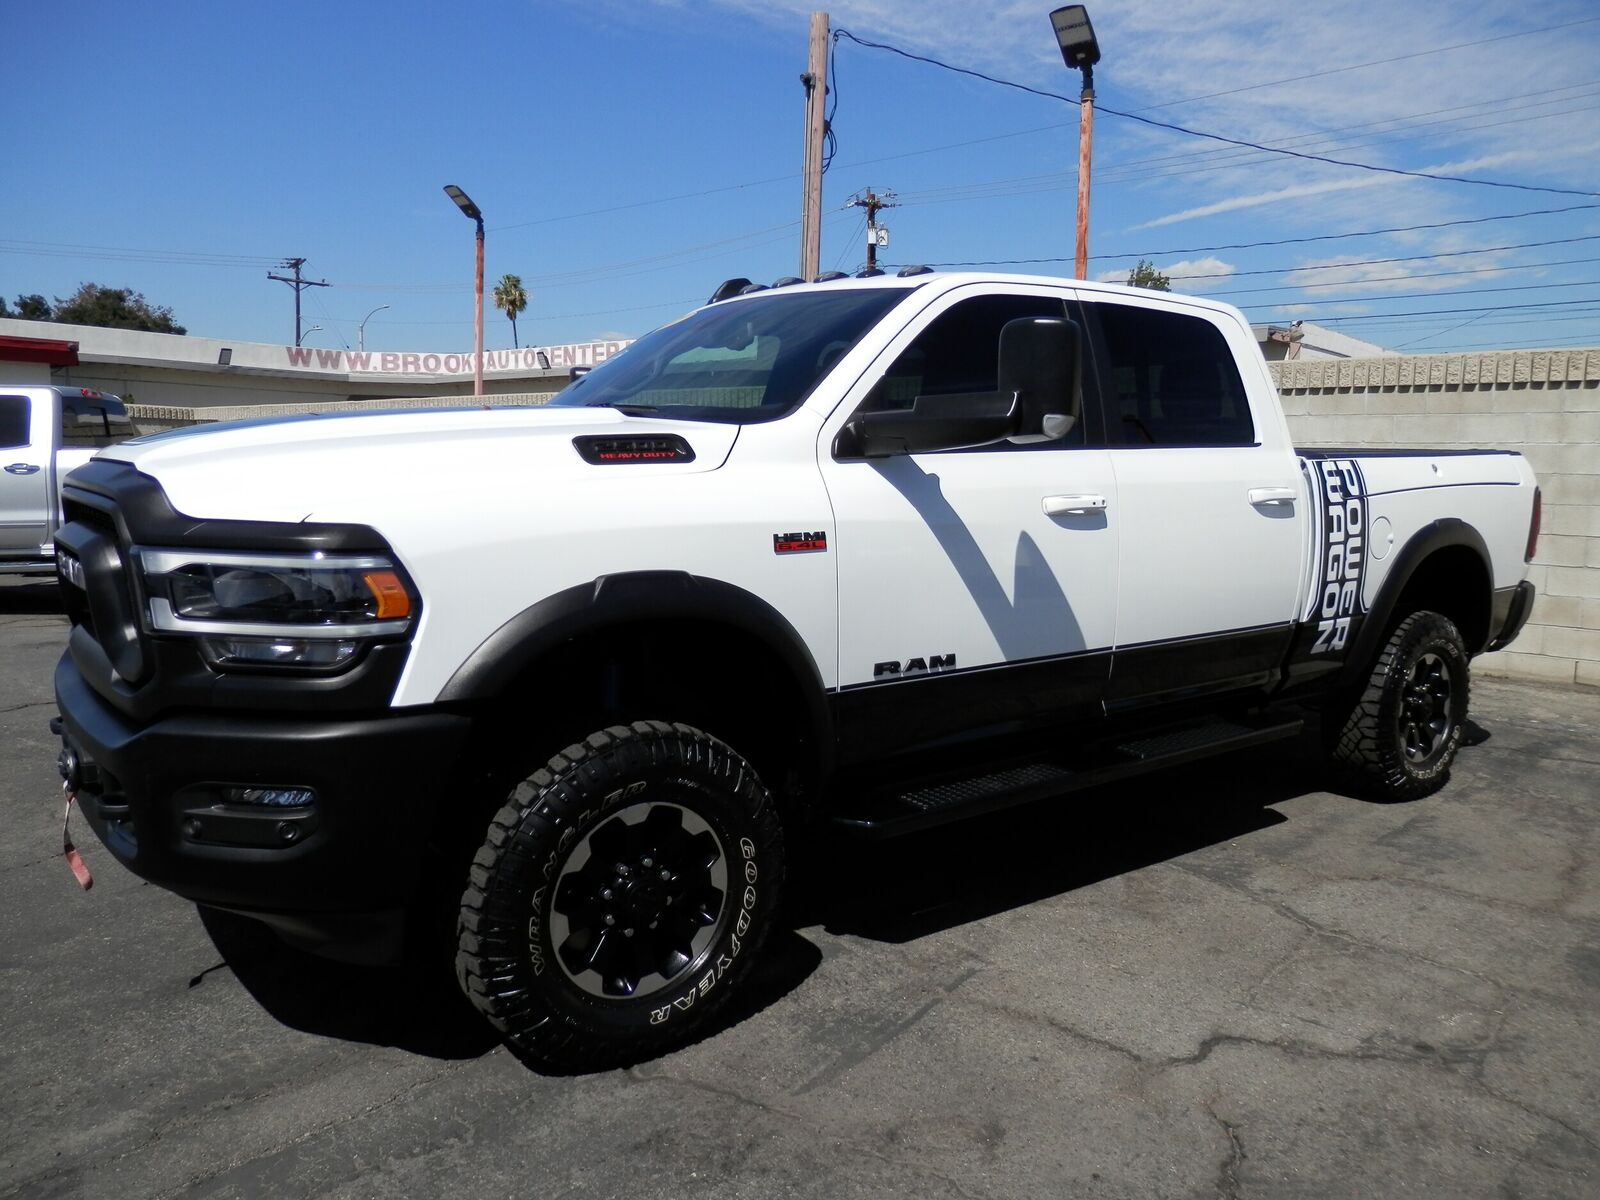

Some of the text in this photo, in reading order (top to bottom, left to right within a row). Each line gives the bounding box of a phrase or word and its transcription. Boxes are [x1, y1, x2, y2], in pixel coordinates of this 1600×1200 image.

[773, 531, 826, 542] HEMI
[1311, 460, 1345, 655] WAGON
[1329, 460, 1362, 652] POWER
[873, 653, 957, 680] RAM
[528, 780, 647, 976] WRANGLER
[650, 837, 758, 1025] GOODYEAR
